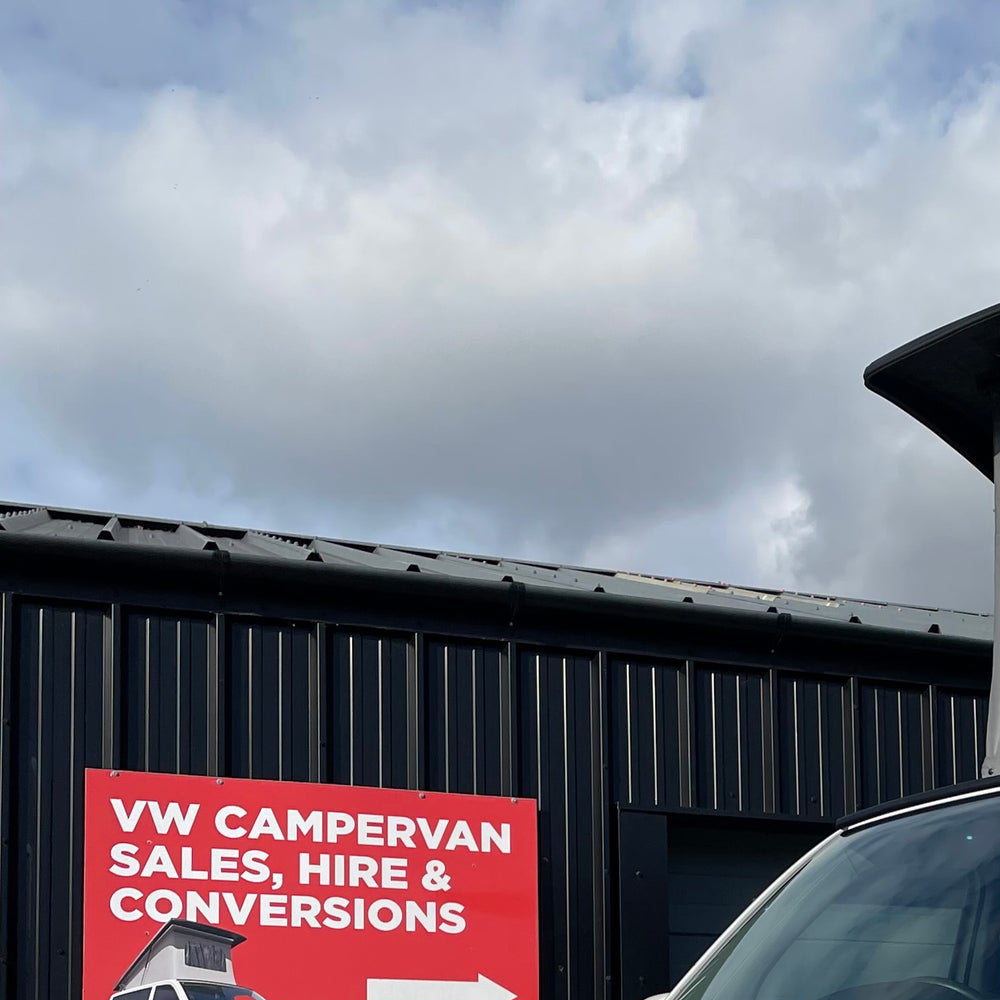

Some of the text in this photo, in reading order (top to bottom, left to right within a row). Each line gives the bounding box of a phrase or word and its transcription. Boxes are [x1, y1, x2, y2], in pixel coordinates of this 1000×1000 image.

[109, 798, 512, 854] VW CAMPERVAN
[109, 843, 452, 892] SALES, HIRE &
[109, 887, 467, 934] CONVERSIONS
